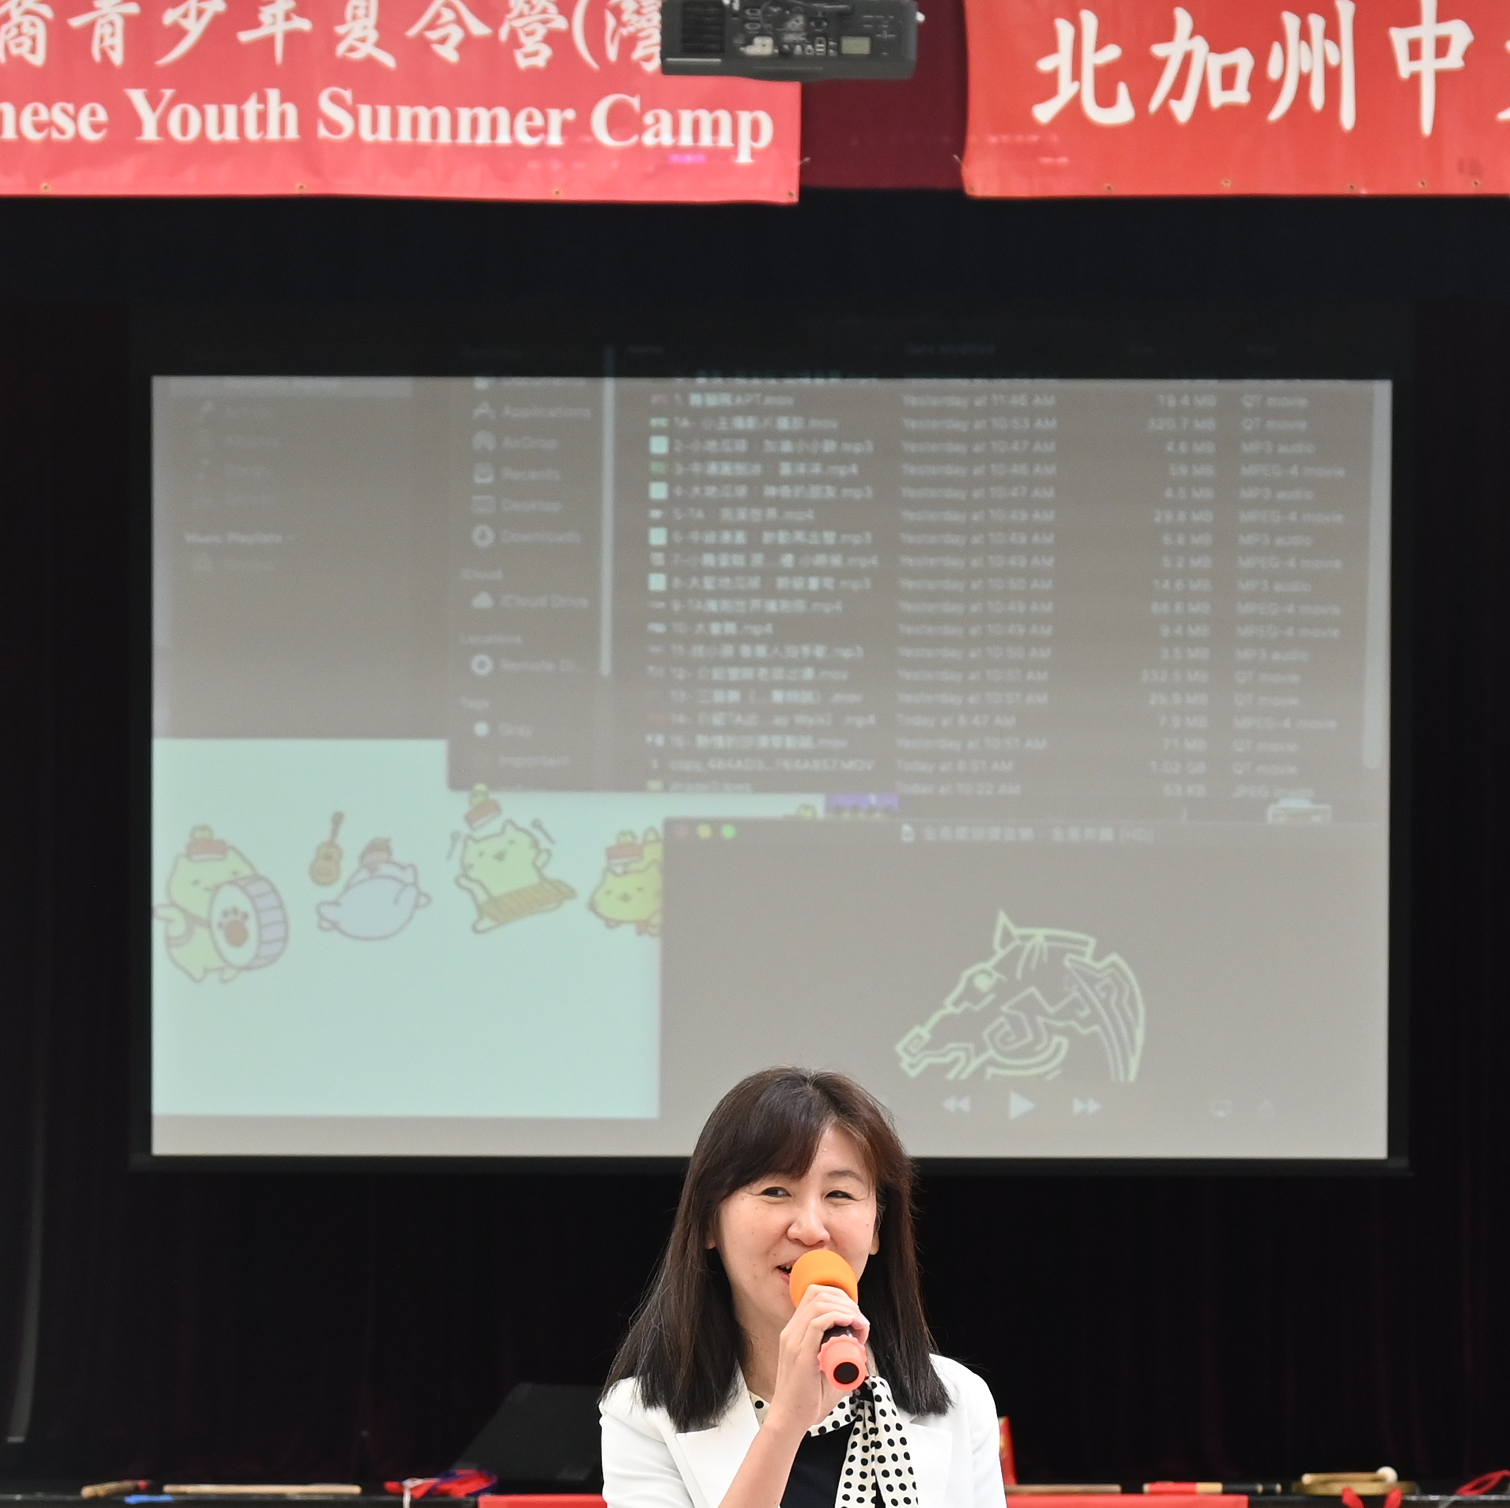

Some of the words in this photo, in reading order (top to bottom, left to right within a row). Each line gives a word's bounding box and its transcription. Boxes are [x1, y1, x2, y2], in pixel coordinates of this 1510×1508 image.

[123, 87, 300, 143] Youth
[316, 87, 575, 146] Summer
[589, 93, 774, 163] Camp
[1032, 394, 1056, 407] AM
[1193, 394, 1217, 408] MB
[1033, 418, 1057, 430] AM
[1193, 418, 1216, 432] MB
[991, 440, 1029, 453] 10:47
[1032, 440, 1056, 453] AM
[1192, 441, 1216, 455] MB
[1033, 463, 1057, 476] AM
[1192, 464, 1215, 478] MB
[989, 486, 1028, 499] 10:47
[1031, 486, 1055, 499] AM
[1191, 487, 1214, 501] MB
[1031, 532, 1055, 545] AM
[1189, 533, 1213, 547] MB
[1030, 555, 1054, 568] AM
[1189, 556, 1212, 570] MB
[1029, 601, 1054, 614] AM
[1187, 602, 1212, 615] MB
[1029, 623, 1053, 637] AM
[1187, 624, 1211, 638] MB
[1025, 692, 1049, 705] AM
[1185, 693, 1209, 706] MB
[992, 714, 1016, 728] AM
[1184, 715, 1208, 729] MB
[1024, 737, 1048, 750] AM
[1184, 738, 1208, 752] MB
[990, 760, 1014, 773] AM
[997, 782, 1022, 795] AM
[1186, 784, 1207, 798] KB
